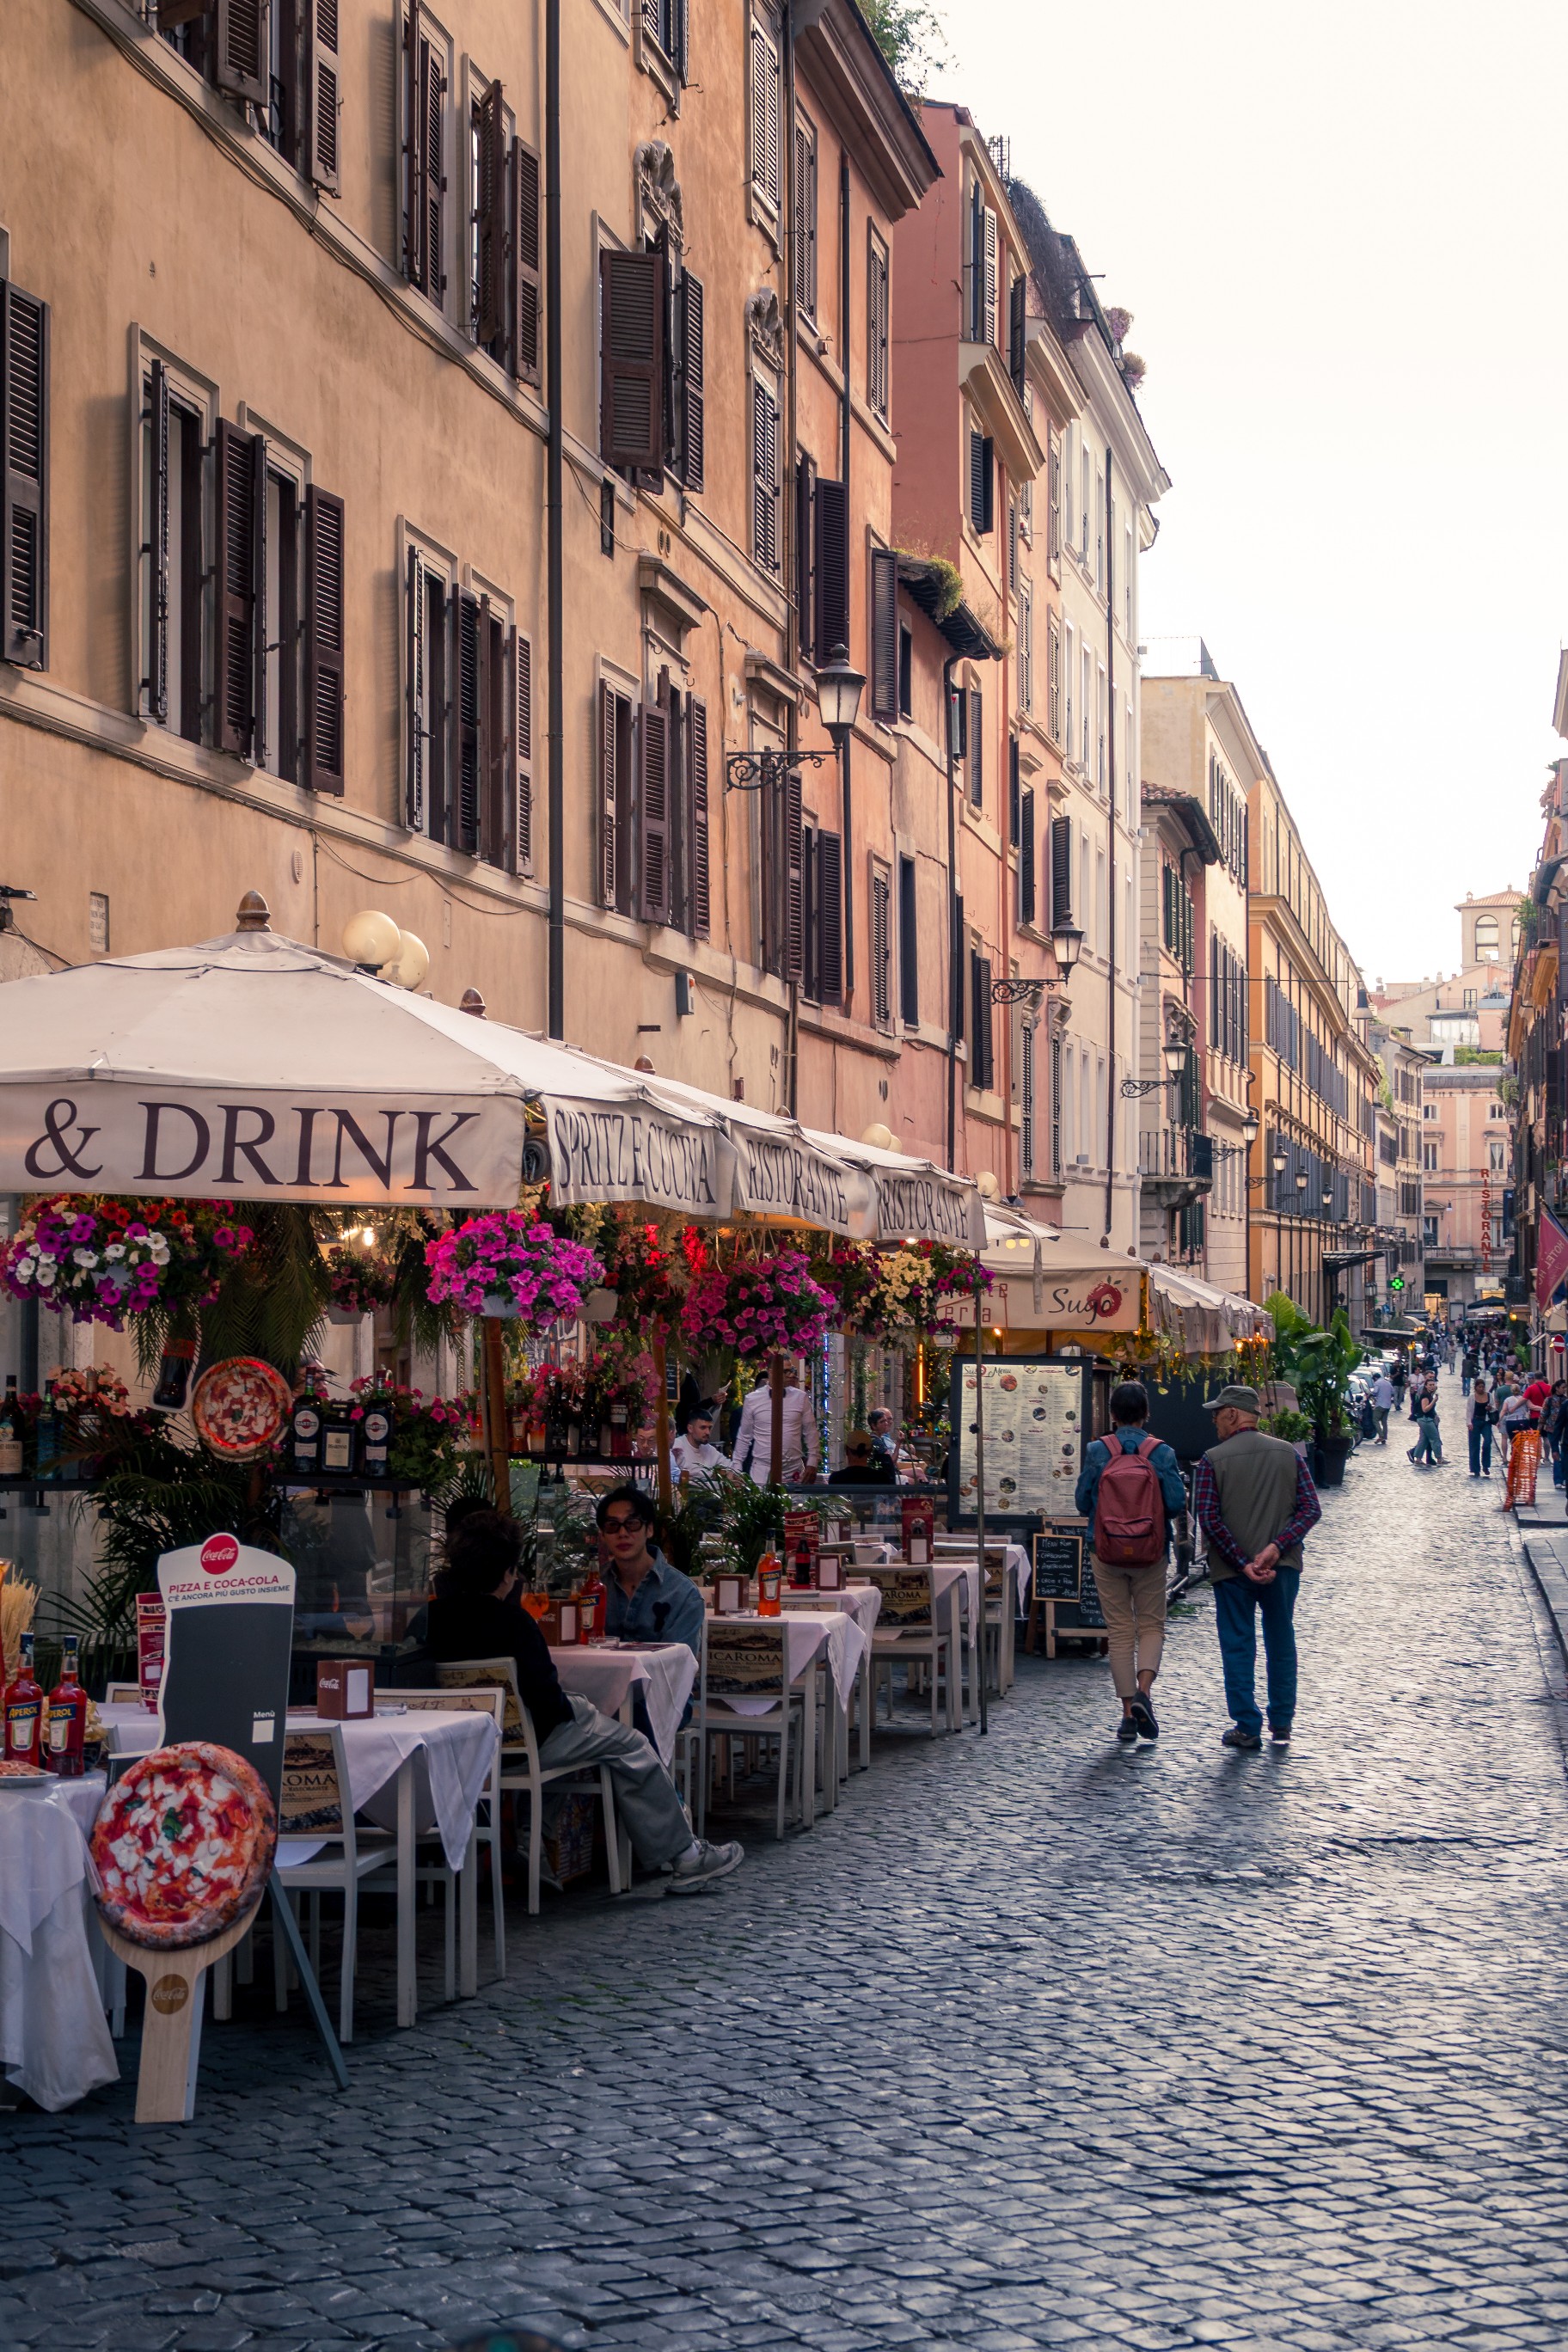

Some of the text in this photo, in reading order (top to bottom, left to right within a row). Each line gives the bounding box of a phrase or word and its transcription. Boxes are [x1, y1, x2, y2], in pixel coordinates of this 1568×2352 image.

[24, 1098, 481, 1191] & DRINK
[554, 1109, 716, 1204] SPRITZ E CUCINA
[745, 1139, 848, 1225] RISTORANTE
[882, 1179, 969, 1240] RISTORANTE
[1480, 1168, 1492, 1272] RISTORANTE
[1048, 1288, 1113, 1325] Sugo
[168, 1575, 279, 1594] PIZZA E COCA-COLA
[181, 1591, 214, 1601] ANCORA
[215, 1589, 229, 1598] PIÙ
[230, 1588, 256, 1596] GUSTO
[258, 1584, 291, 1594] INSIEME
[9, 1706, 38, 1718] APEROL
[253, 1709, 276, 1718] Menù
